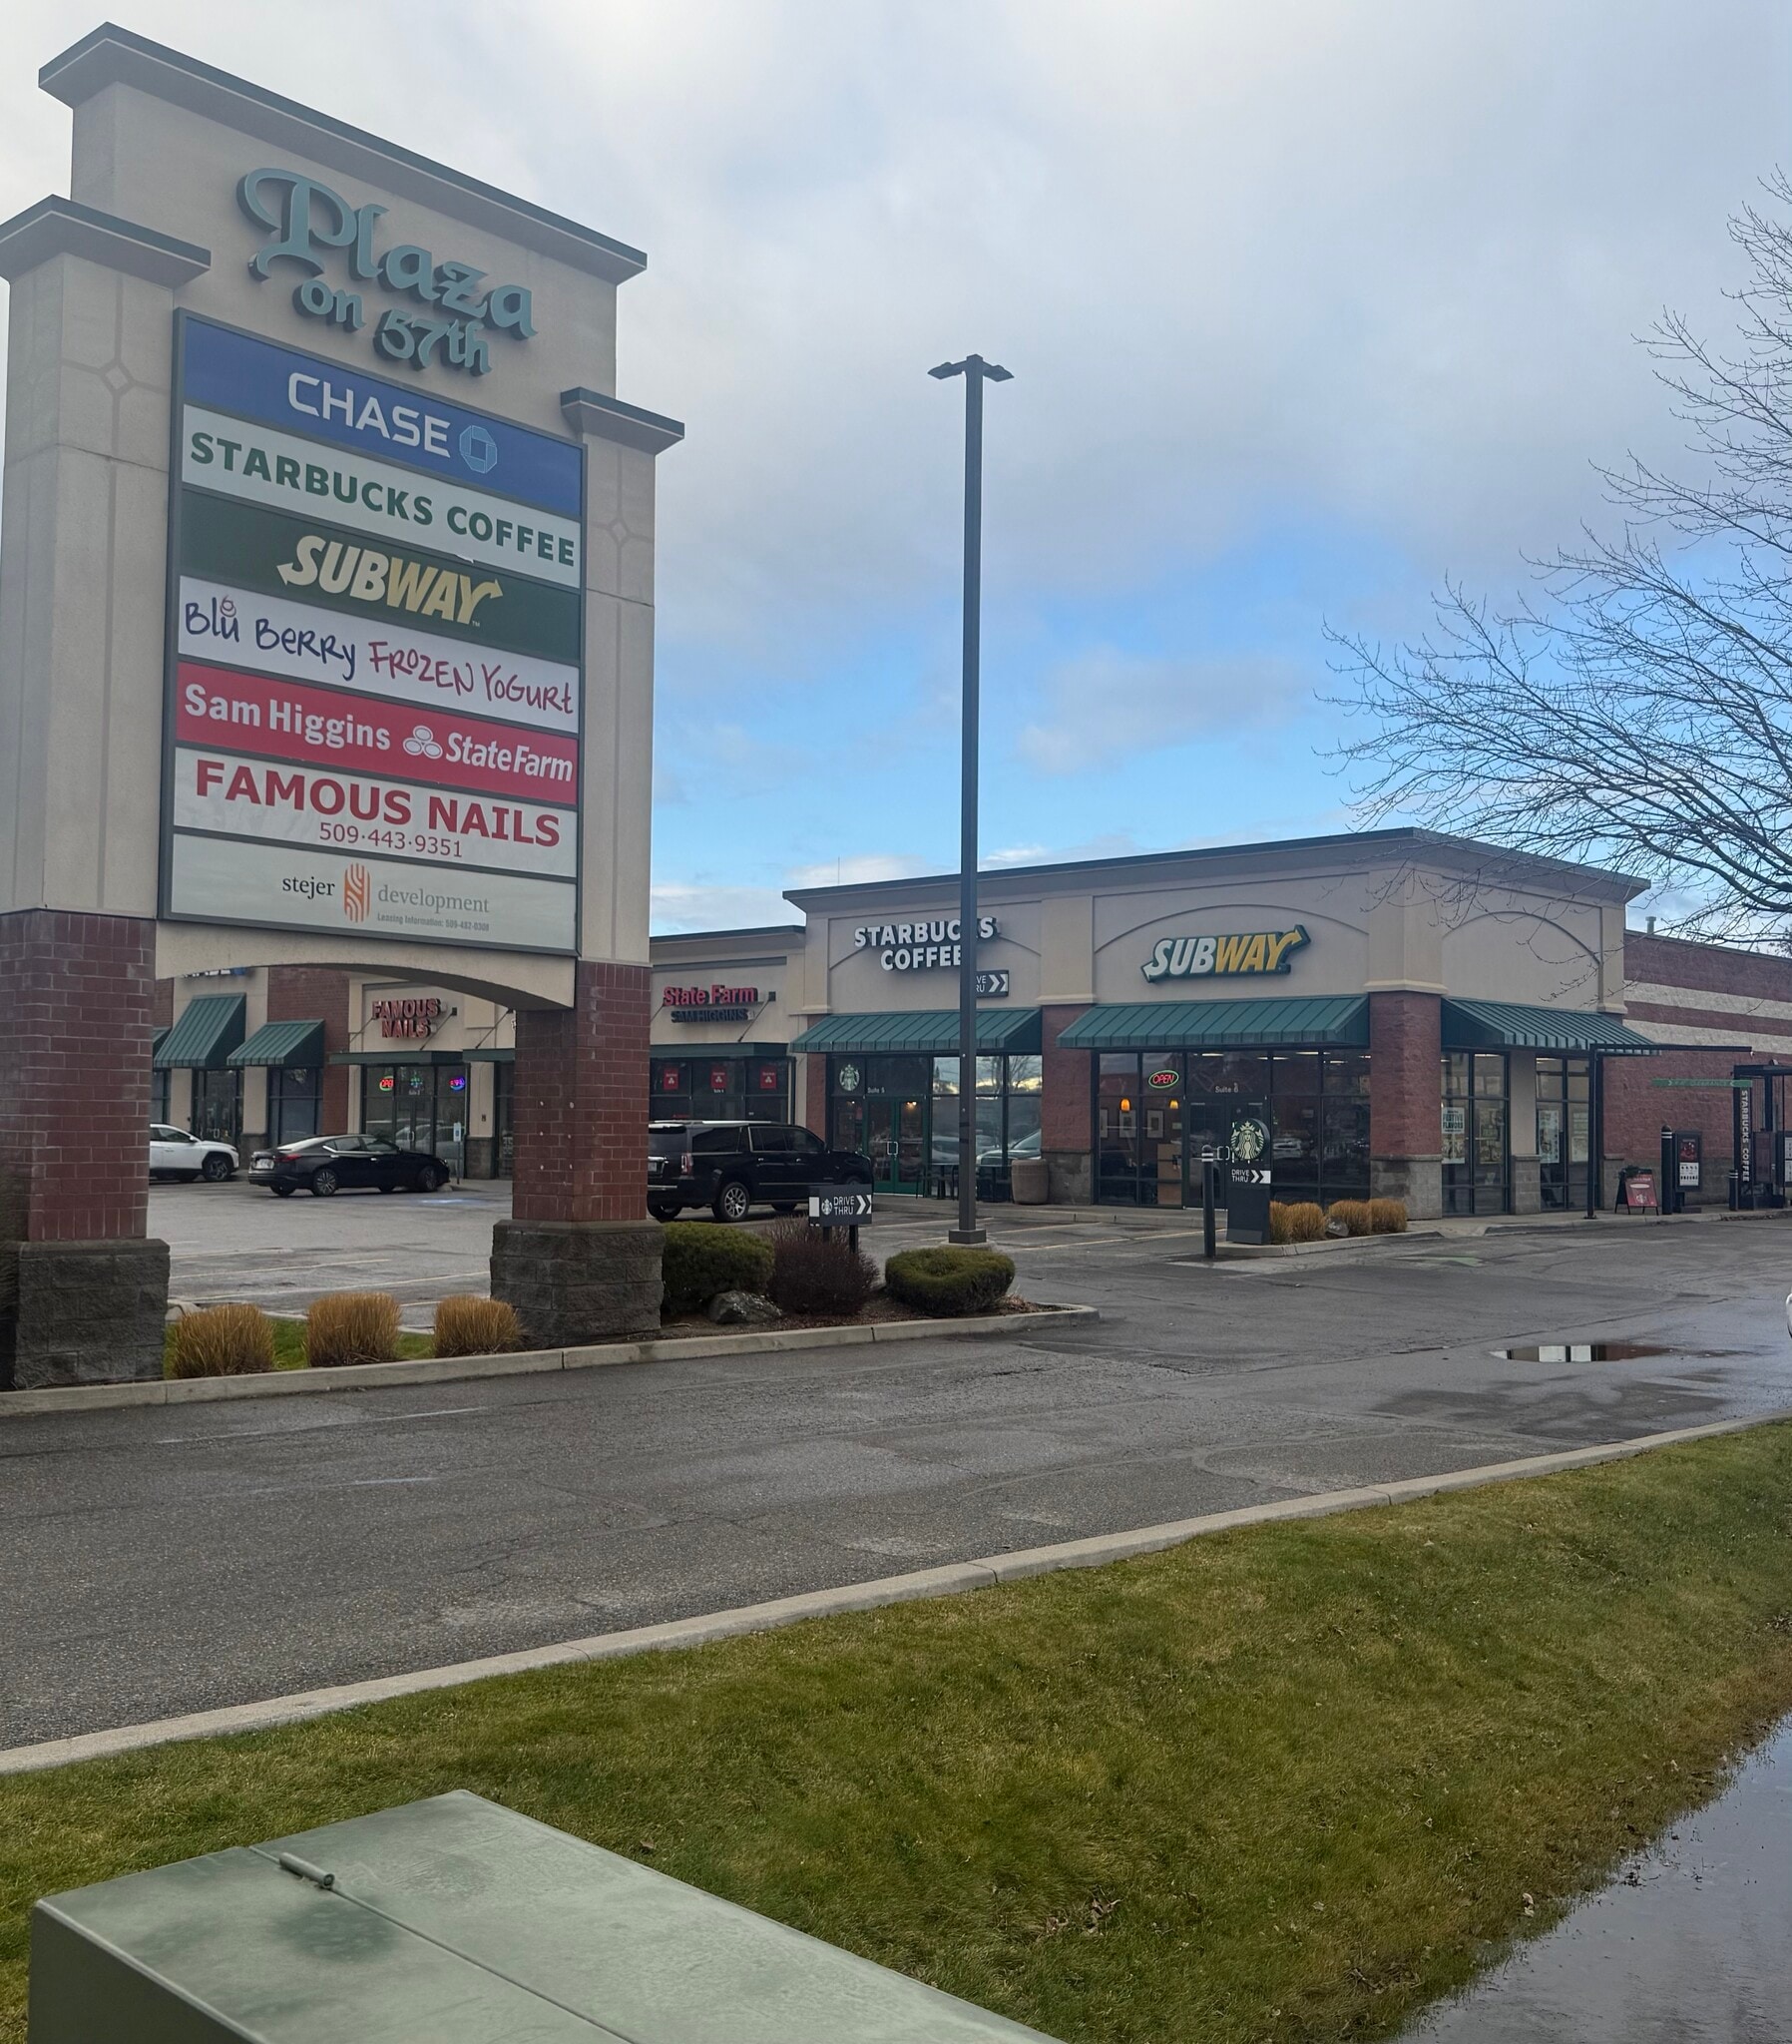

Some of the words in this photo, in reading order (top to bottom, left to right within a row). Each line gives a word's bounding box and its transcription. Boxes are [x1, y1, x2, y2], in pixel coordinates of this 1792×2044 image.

[236, 168, 538, 339] Plaza
[294, 279, 365, 331] on
[374, 309, 492, 376] 57th
[288, 372, 451, 458] CHASE
[191, 432, 433, 525] STARBUCKS
[446, 505, 575, 567] COFFEE
[276, 535, 503, 625] SUBWAY
[185, 684, 260, 727] Sam
[268, 699, 391, 750] Higgins
[196, 759, 412, 825] FAMOUS
[428, 796, 561, 847] NAILS
[281, 876, 335, 899] stejer
[377, 884, 490, 914] development
[377, 913, 404, 925] Leasing
[854, 917, 995, 947] STARBUCS
[1142, 929, 1303, 981] SUBWAY
[372, 998, 439, 1019] FAMOUS
[664, 986, 705, 1007] State
[711, 984, 756, 1004] Farm
[381, 1018, 430, 1038] NAILS
[1152, 1074, 1174, 1085] OPEN
[1214, 1085, 1231, 1094] Suite
[833, 1196, 855, 1206] DRIVE
[833, 1206, 854, 1216] THRU
